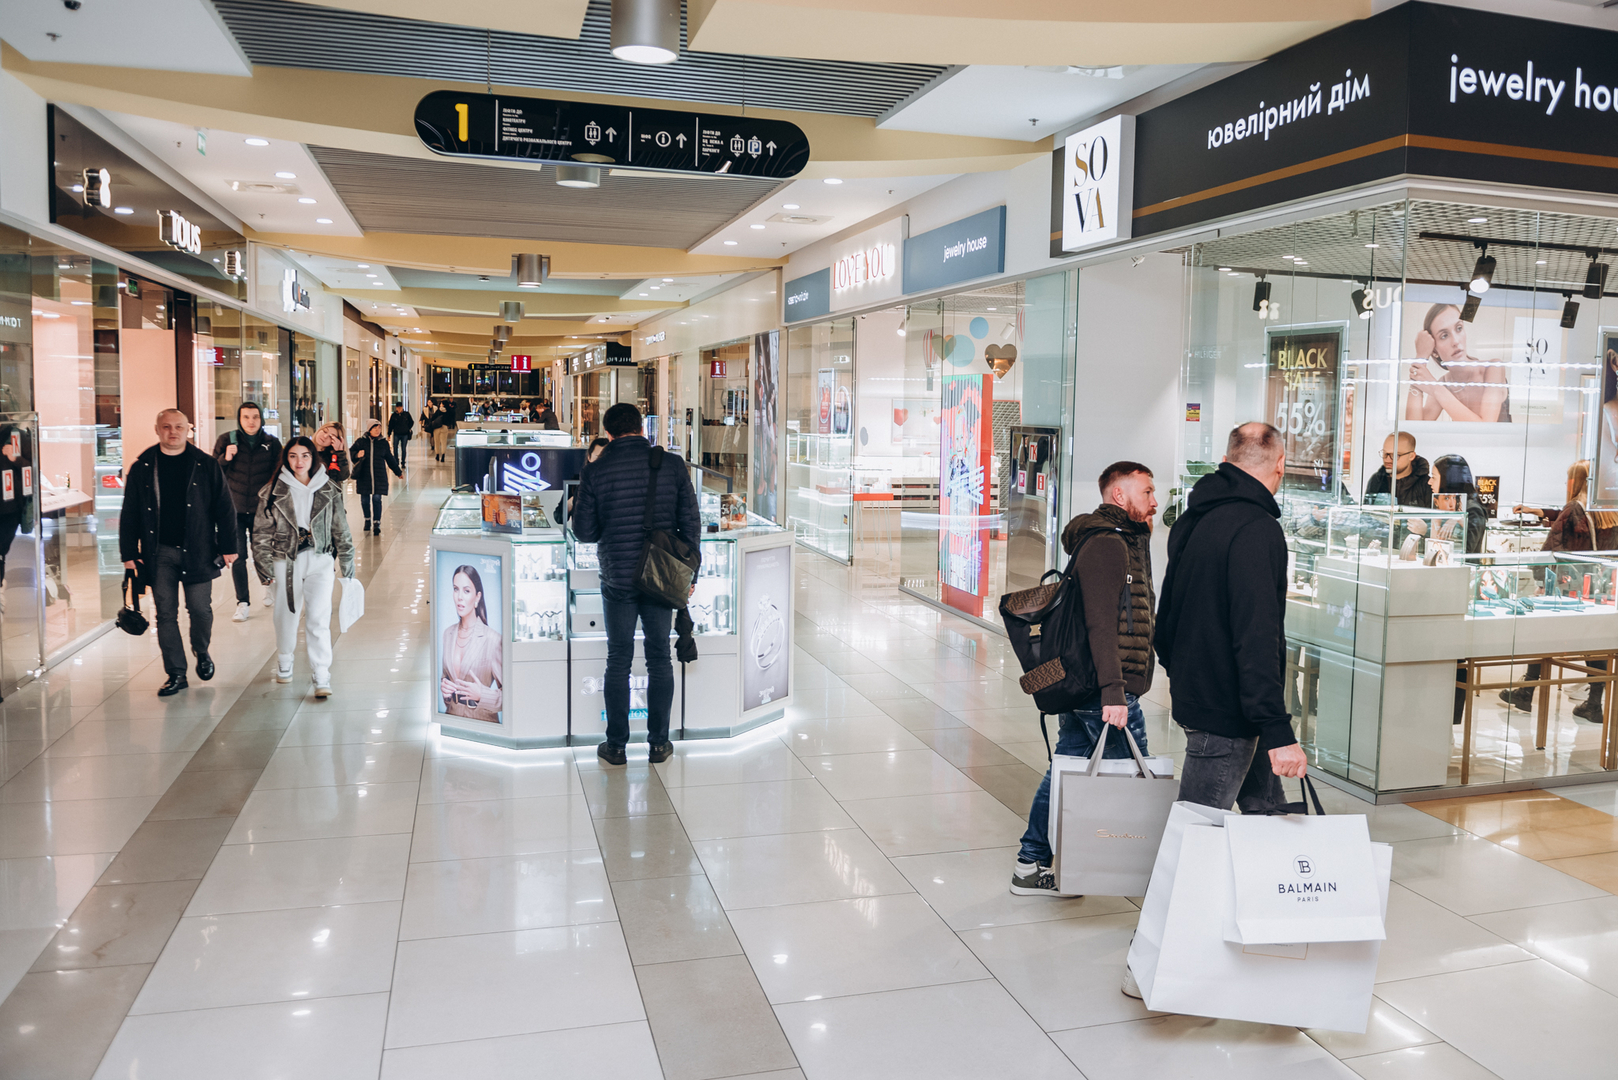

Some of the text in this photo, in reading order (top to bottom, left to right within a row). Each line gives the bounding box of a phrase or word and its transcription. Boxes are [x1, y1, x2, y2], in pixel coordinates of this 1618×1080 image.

[1450, 53, 1566, 116] jewelry
[455, 102, 469, 143] 1
[1207, 68, 1371, 150] ювелірний дім
[1073, 135, 1109, 188] SO
[1072, 187, 1108, 233] VA
[159, 209, 202, 255] TOUS
[943, 235, 988, 263] jewelry house
[833, 243, 895, 291] LOVE YOU
[1278, 347, 1328, 370] BLACK
[1283, 370, 1321, 391] SALE
[1479, 485, 1495, 493] SALE
[1278, 881, 1338, 894] BALMAIN
[1297, 895, 1319, 903] PARIS
